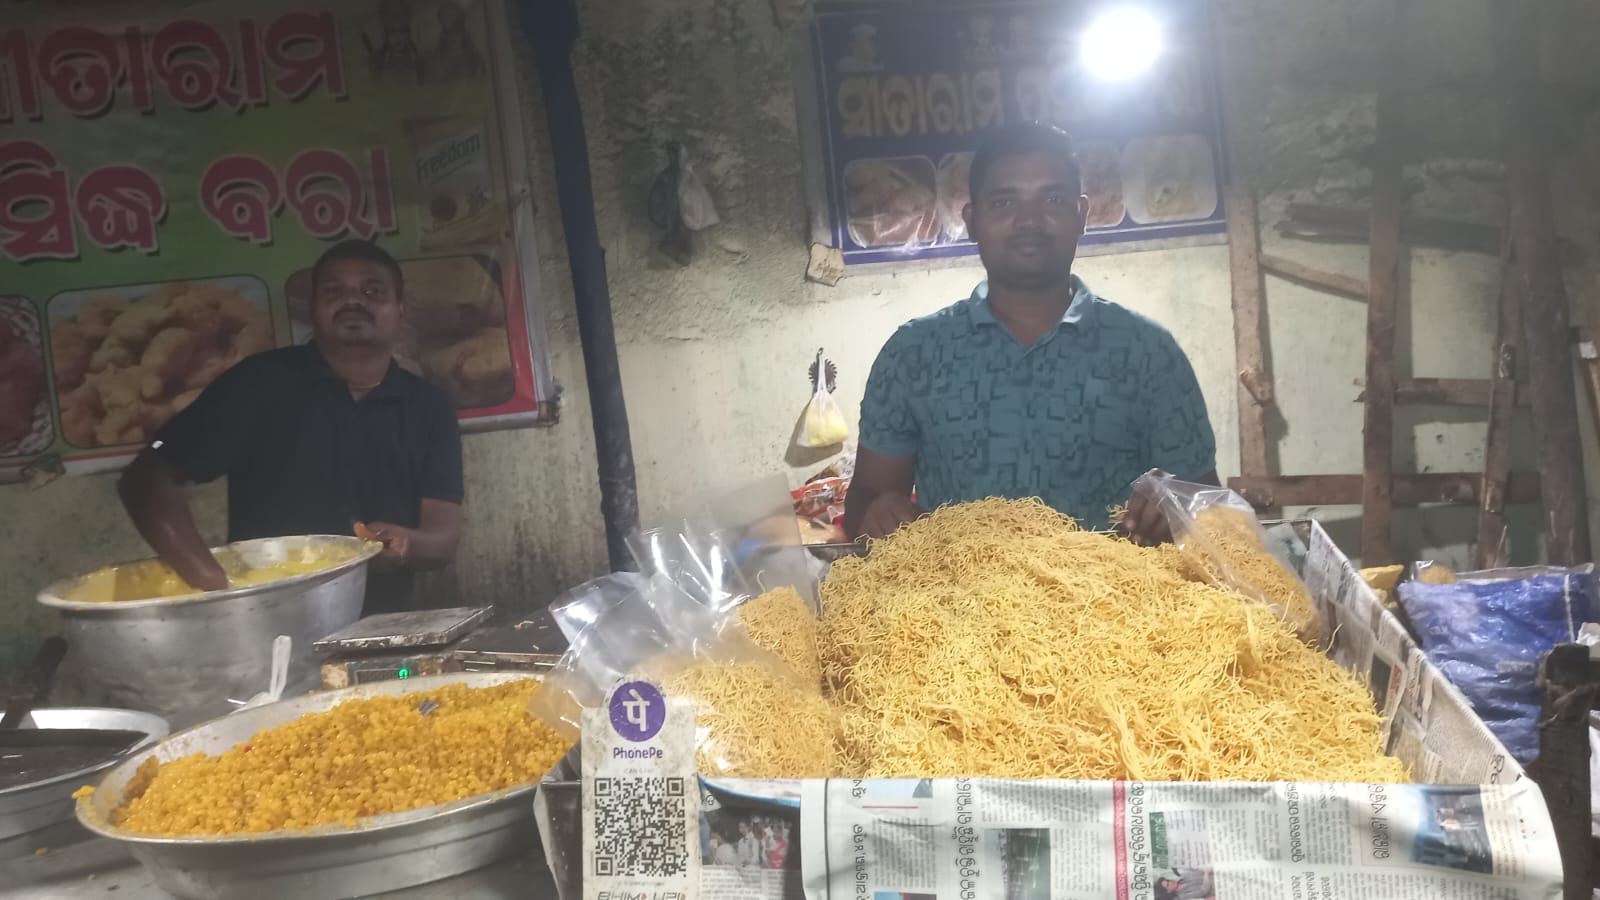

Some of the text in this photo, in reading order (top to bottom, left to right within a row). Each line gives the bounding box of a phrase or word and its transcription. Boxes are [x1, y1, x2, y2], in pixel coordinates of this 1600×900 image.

[0, 11, 348, 120] ୀତାରାମ
[416, 133, 481, 182] Freedom
[202, 147, 397, 244] ବରା
[613, 746, 663, 759] PhonePe
